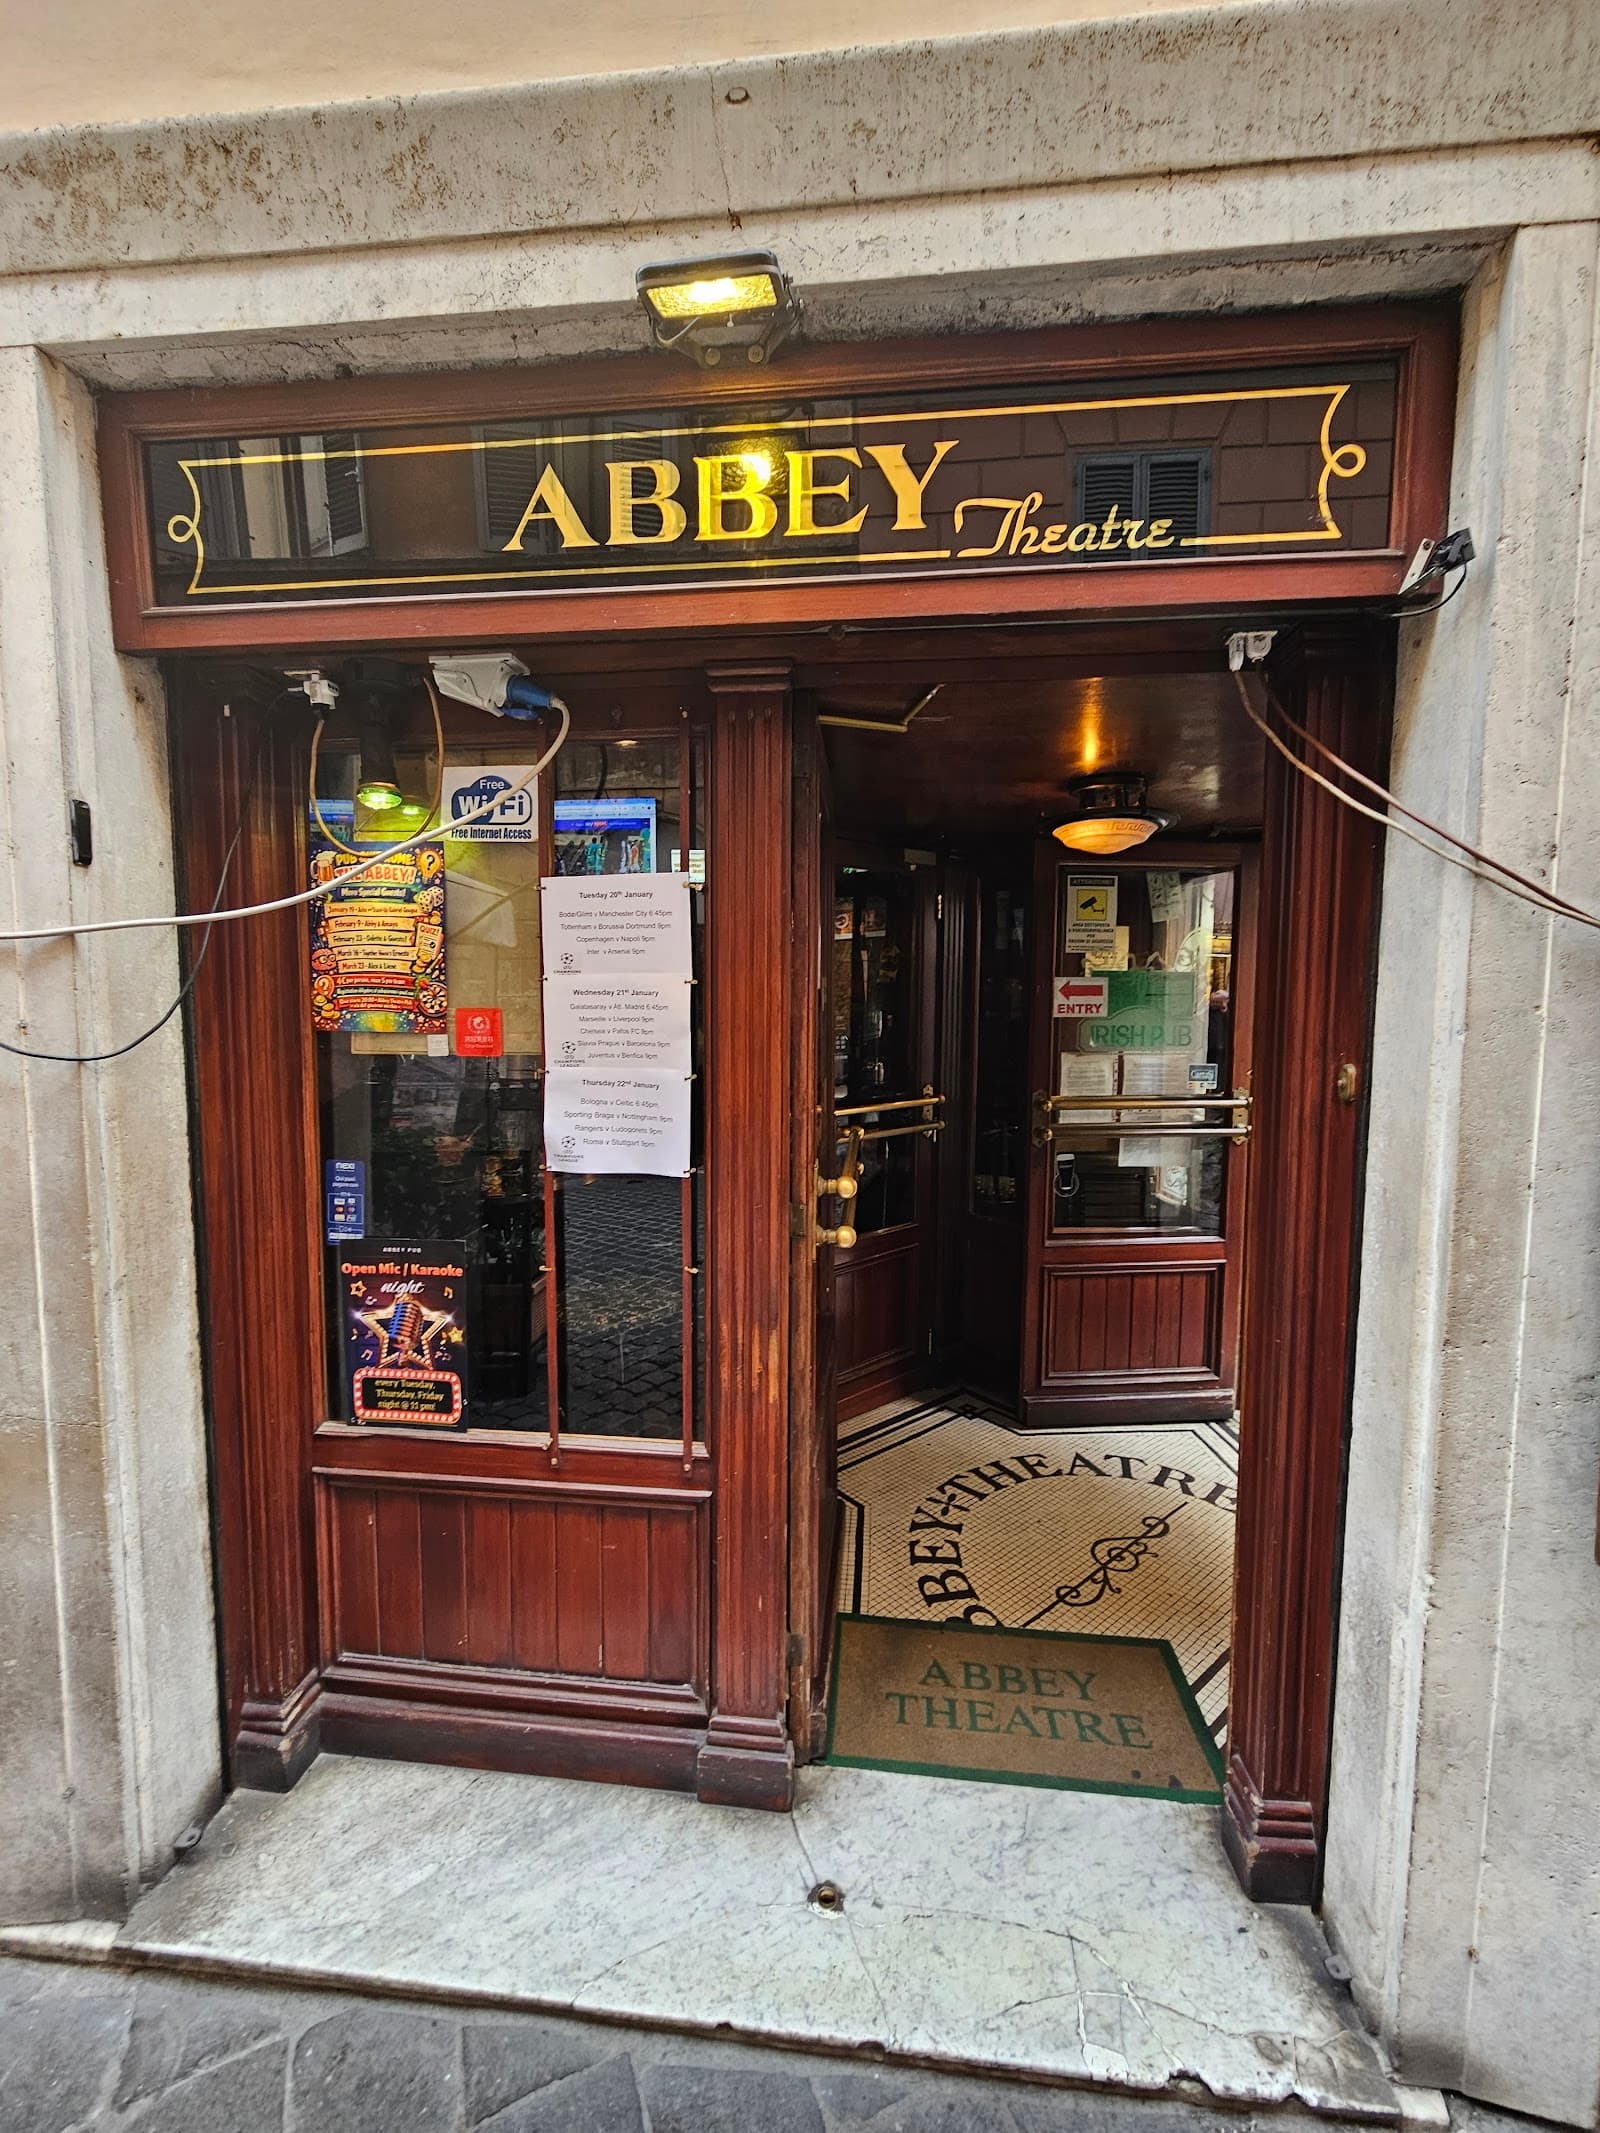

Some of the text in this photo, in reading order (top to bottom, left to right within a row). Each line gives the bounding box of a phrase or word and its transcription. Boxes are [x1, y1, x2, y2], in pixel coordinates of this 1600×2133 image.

[502, 440, 1175, 558] ABBEY Theatre
[480, 780, 505, 790] Free
[452, 827, 532, 839] Free Internet Access
[365, 865, 416, 883] ABBEY!
[624, 891, 653, 899] January
[635, 910, 648, 918] City
[420, 926, 440, 936] QUIZ!
[1057, 1003, 1103, 1014] ENTRY
[582, 1080, 615, 1088] Thursday
[633, 1082, 660, 1090] January
[580, 1098, 608, 1106] Bologna
[564, 1111, 592, 1119] Sporting
[595, 1112, 614, 1120] Braga
[621, 1113, 657, 1121] Nottingham
[341, 1263, 376, 1276] Open
[379, 1262, 401, 1274] Mic
[410, 1264, 463, 1276] Karaoke
[380, 1280, 425, 1295] night
[375, 1380, 400, 1388] every
[417, 1391, 445, 1401] Friday
[919, 1659, 1098, 1701] ABBEY
[885, 1693, 1153, 1749] THEATRE
